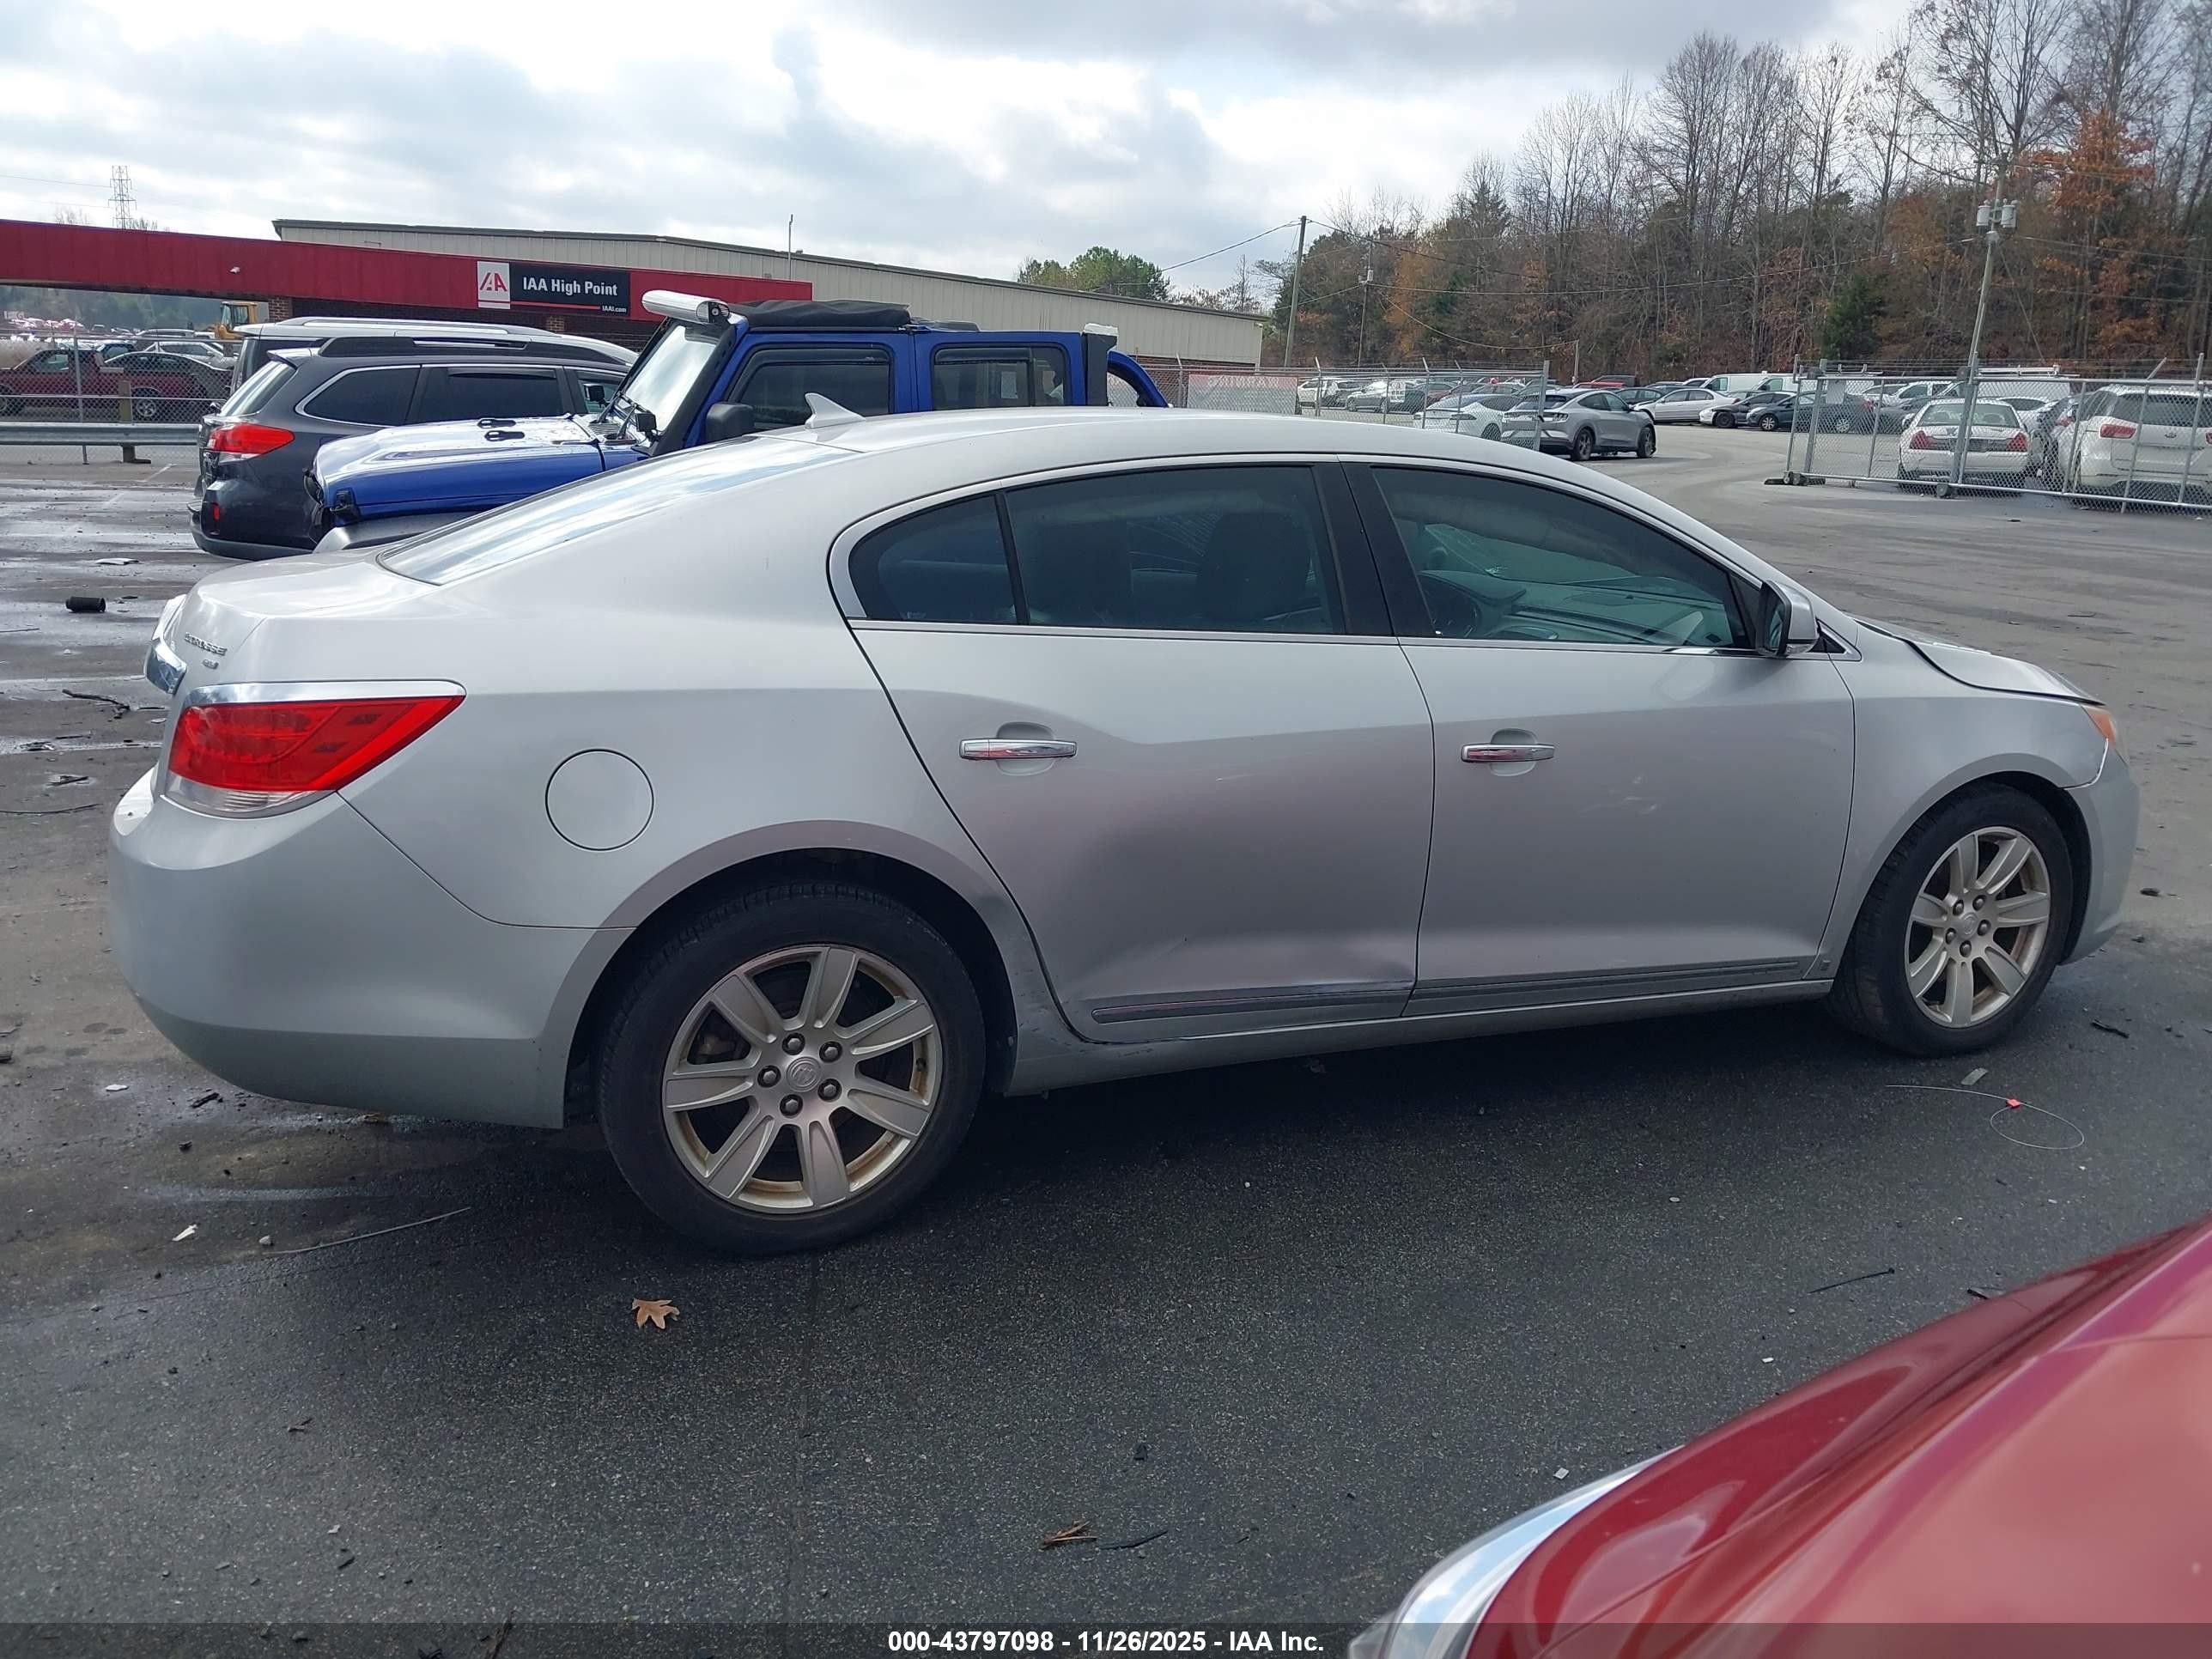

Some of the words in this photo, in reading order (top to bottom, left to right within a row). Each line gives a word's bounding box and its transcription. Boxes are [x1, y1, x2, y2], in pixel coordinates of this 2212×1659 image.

[523, 276, 548, 292] IAA
[551, 277, 580, 296] High
[585, 281, 617, 296] Point
